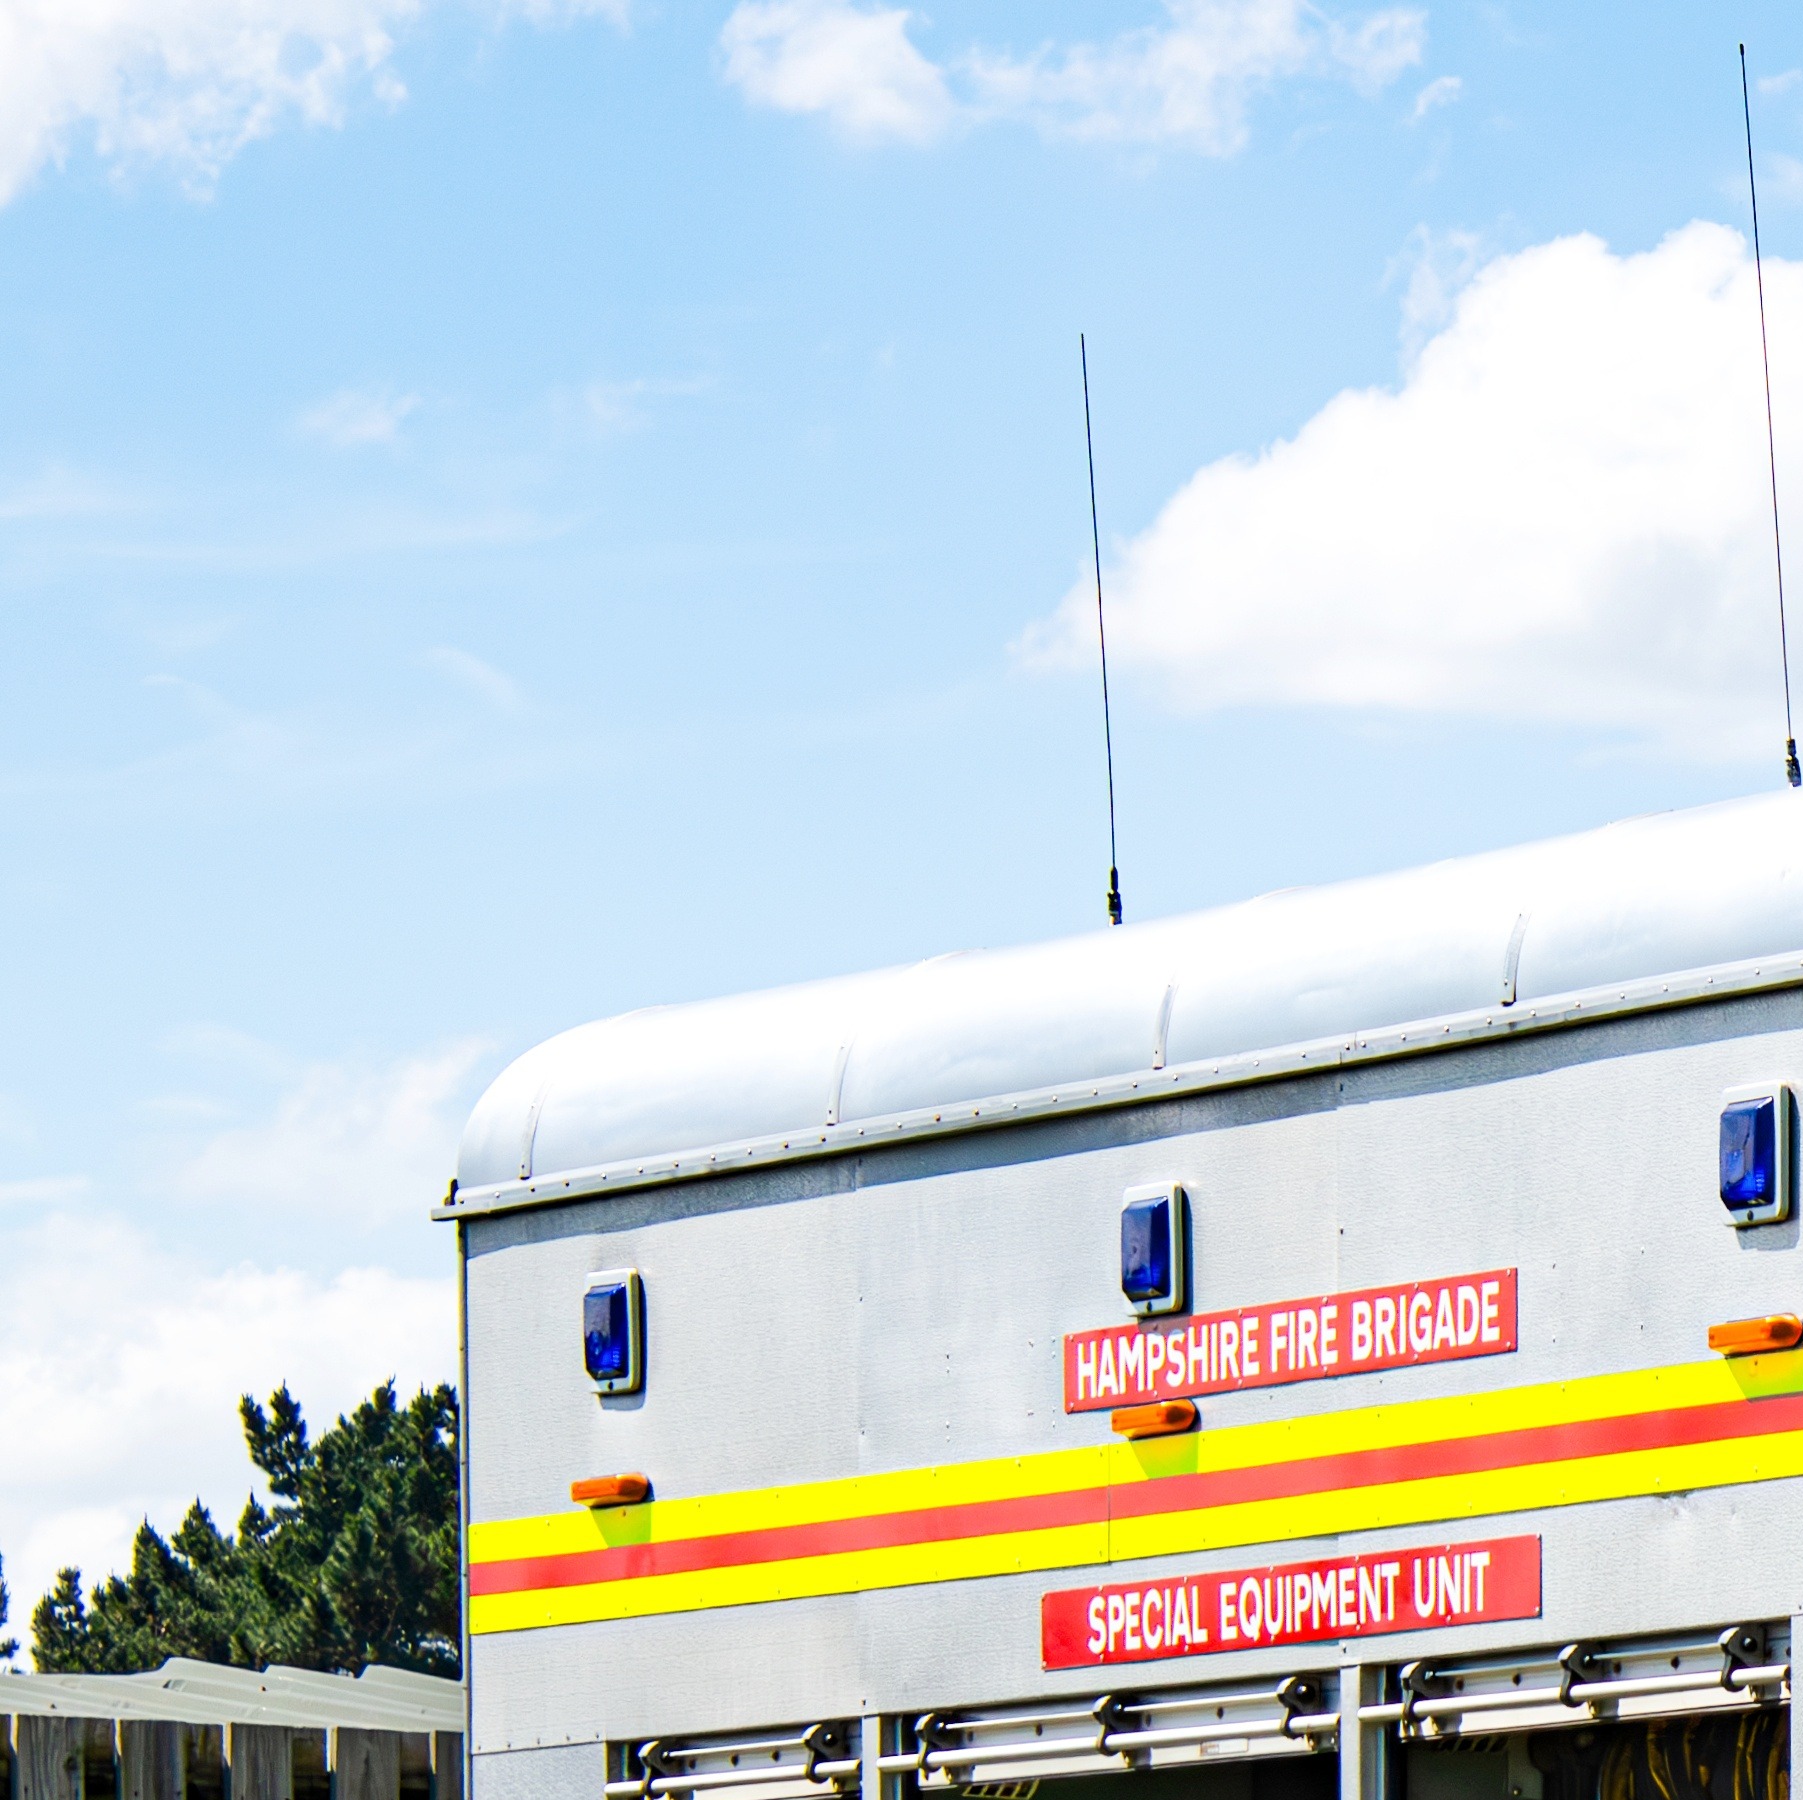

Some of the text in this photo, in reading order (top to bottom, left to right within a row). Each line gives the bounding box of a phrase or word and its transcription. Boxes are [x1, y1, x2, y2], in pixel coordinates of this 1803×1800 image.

[1076, 1281, 1500, 1400] HAMPSHIRE FIRE BRIGADE
[1086, 1551, 1491, 1657] SPECIAL EQUIPMENT UNIT
